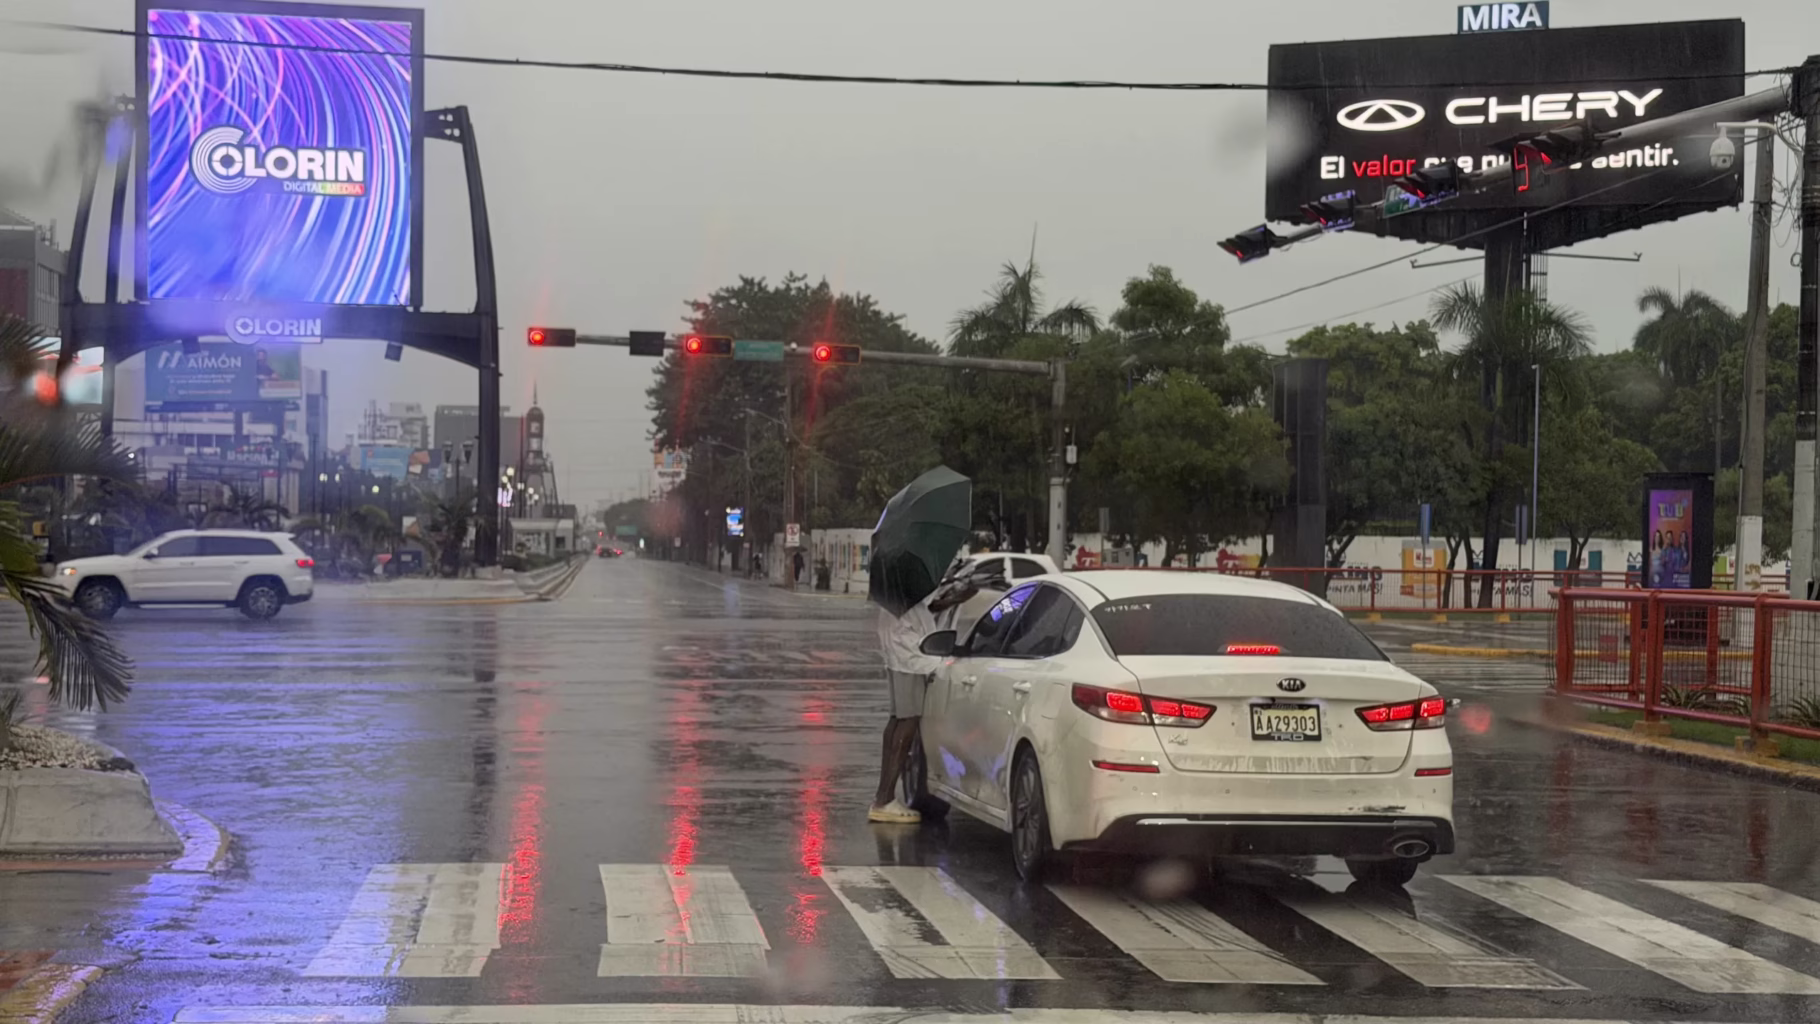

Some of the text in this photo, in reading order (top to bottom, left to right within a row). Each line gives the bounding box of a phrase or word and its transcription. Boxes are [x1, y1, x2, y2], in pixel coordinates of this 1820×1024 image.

[1462, 3, 1543, 31] MIRA
[1445, 88, 1664, 125] CHERY
[190, 126, 365, 194] COLORIN
[1320, 155, 1345, 179] El
[1352, 154, 1417, 178] valor
[284, 181, 363, 194] DIGITAL MEDIA
[1282, 679, 1302, 690] KIA
[1256, 715, 1316, 732] AA29303
[1271, 733, 1304, 741] TRD
